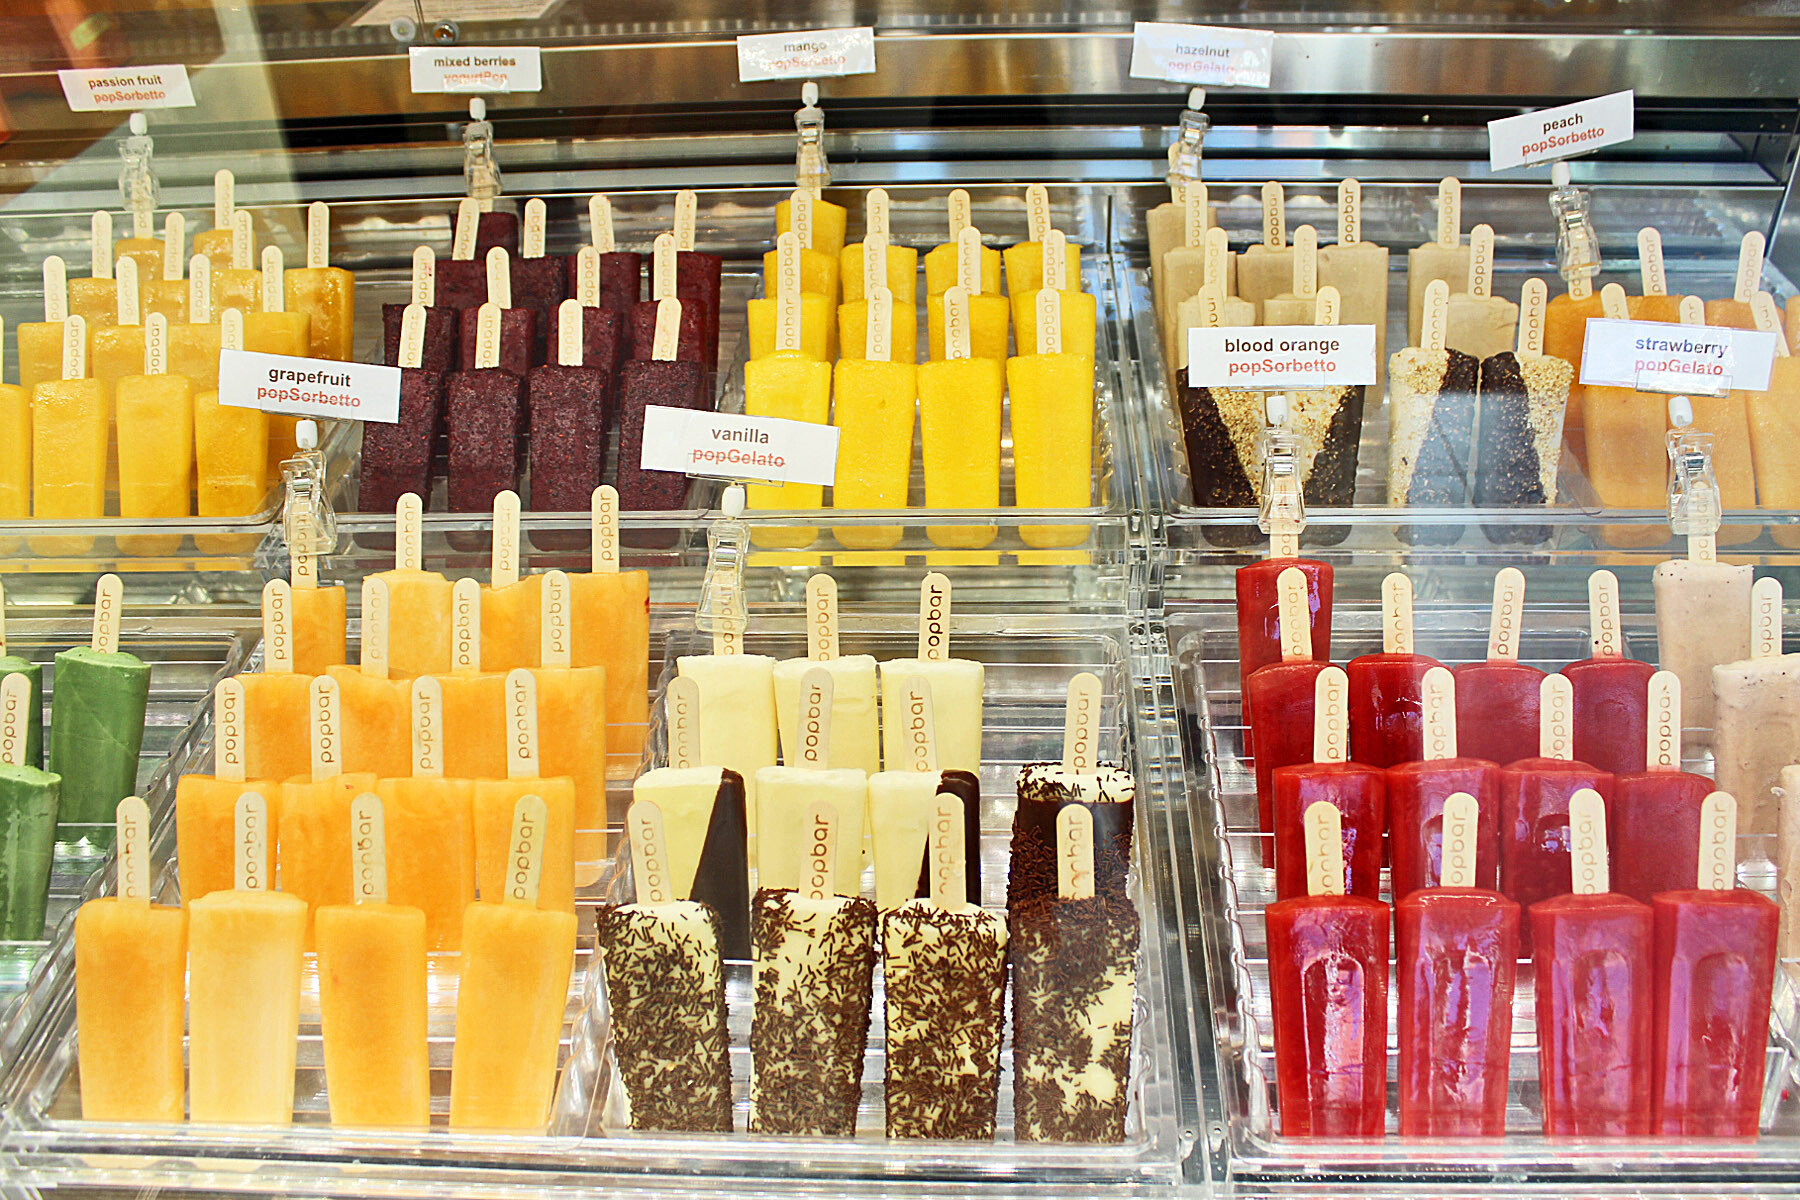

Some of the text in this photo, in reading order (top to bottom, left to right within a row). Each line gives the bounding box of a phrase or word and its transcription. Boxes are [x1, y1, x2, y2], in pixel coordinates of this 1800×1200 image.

[434, 56, 517, 67] mixed berries
[783, 41, 828, 53] mango
[1175, 43, 1230, 58] hazelnut
[88, 74, 163, 90] passion fruit
[93, 89, 167, 104] popSorbetto
[1522, 127, 1605, 157] popSorbetto
[1543, 112, 1583, 134] peach
[1343, 187, 1356, 243] popbar
[268, 368, 352, 388] grapefruit
[1225, 338, 1340, 355] blood orange
[1229, 358, 1337, 377] popSorbetto
[1635, 336, 1728, 358] strawberry
[1635, 358, 1723, 376] popGelato
[257, 386, 361, 408] popSorbetto
[692, 448, 786, 468] popGelato
[711, 427, 769, 444] vanilla
[598, 492, 615, 561] popbar
[271, 588, 287, 660] popbar
[456, 593, 470, 666] popbar
[549, 578, 566, 653] popbar
[815, 587, 833, 661] popbar
[926, 584, 944, 660] popbar
[1496, 583, 1515, 656] popbar
[1598, 583, 1616, 657] popbar
[1758, 595, 1775, 656] opbar
[2, 688, 17, 764] popbar
[222, 686, 239, 764] popbar
[318, 685, 335, 763] popbar
[804, 684, 822, 762] popbar
[909, 691, 932, 773] popbar
[1551, 683, 1566, 761] popbar
[513, 812, 535, 900] popbar
[809, 814, 830, 900] popbar
[1449, 810, 1468, 885] opbar
